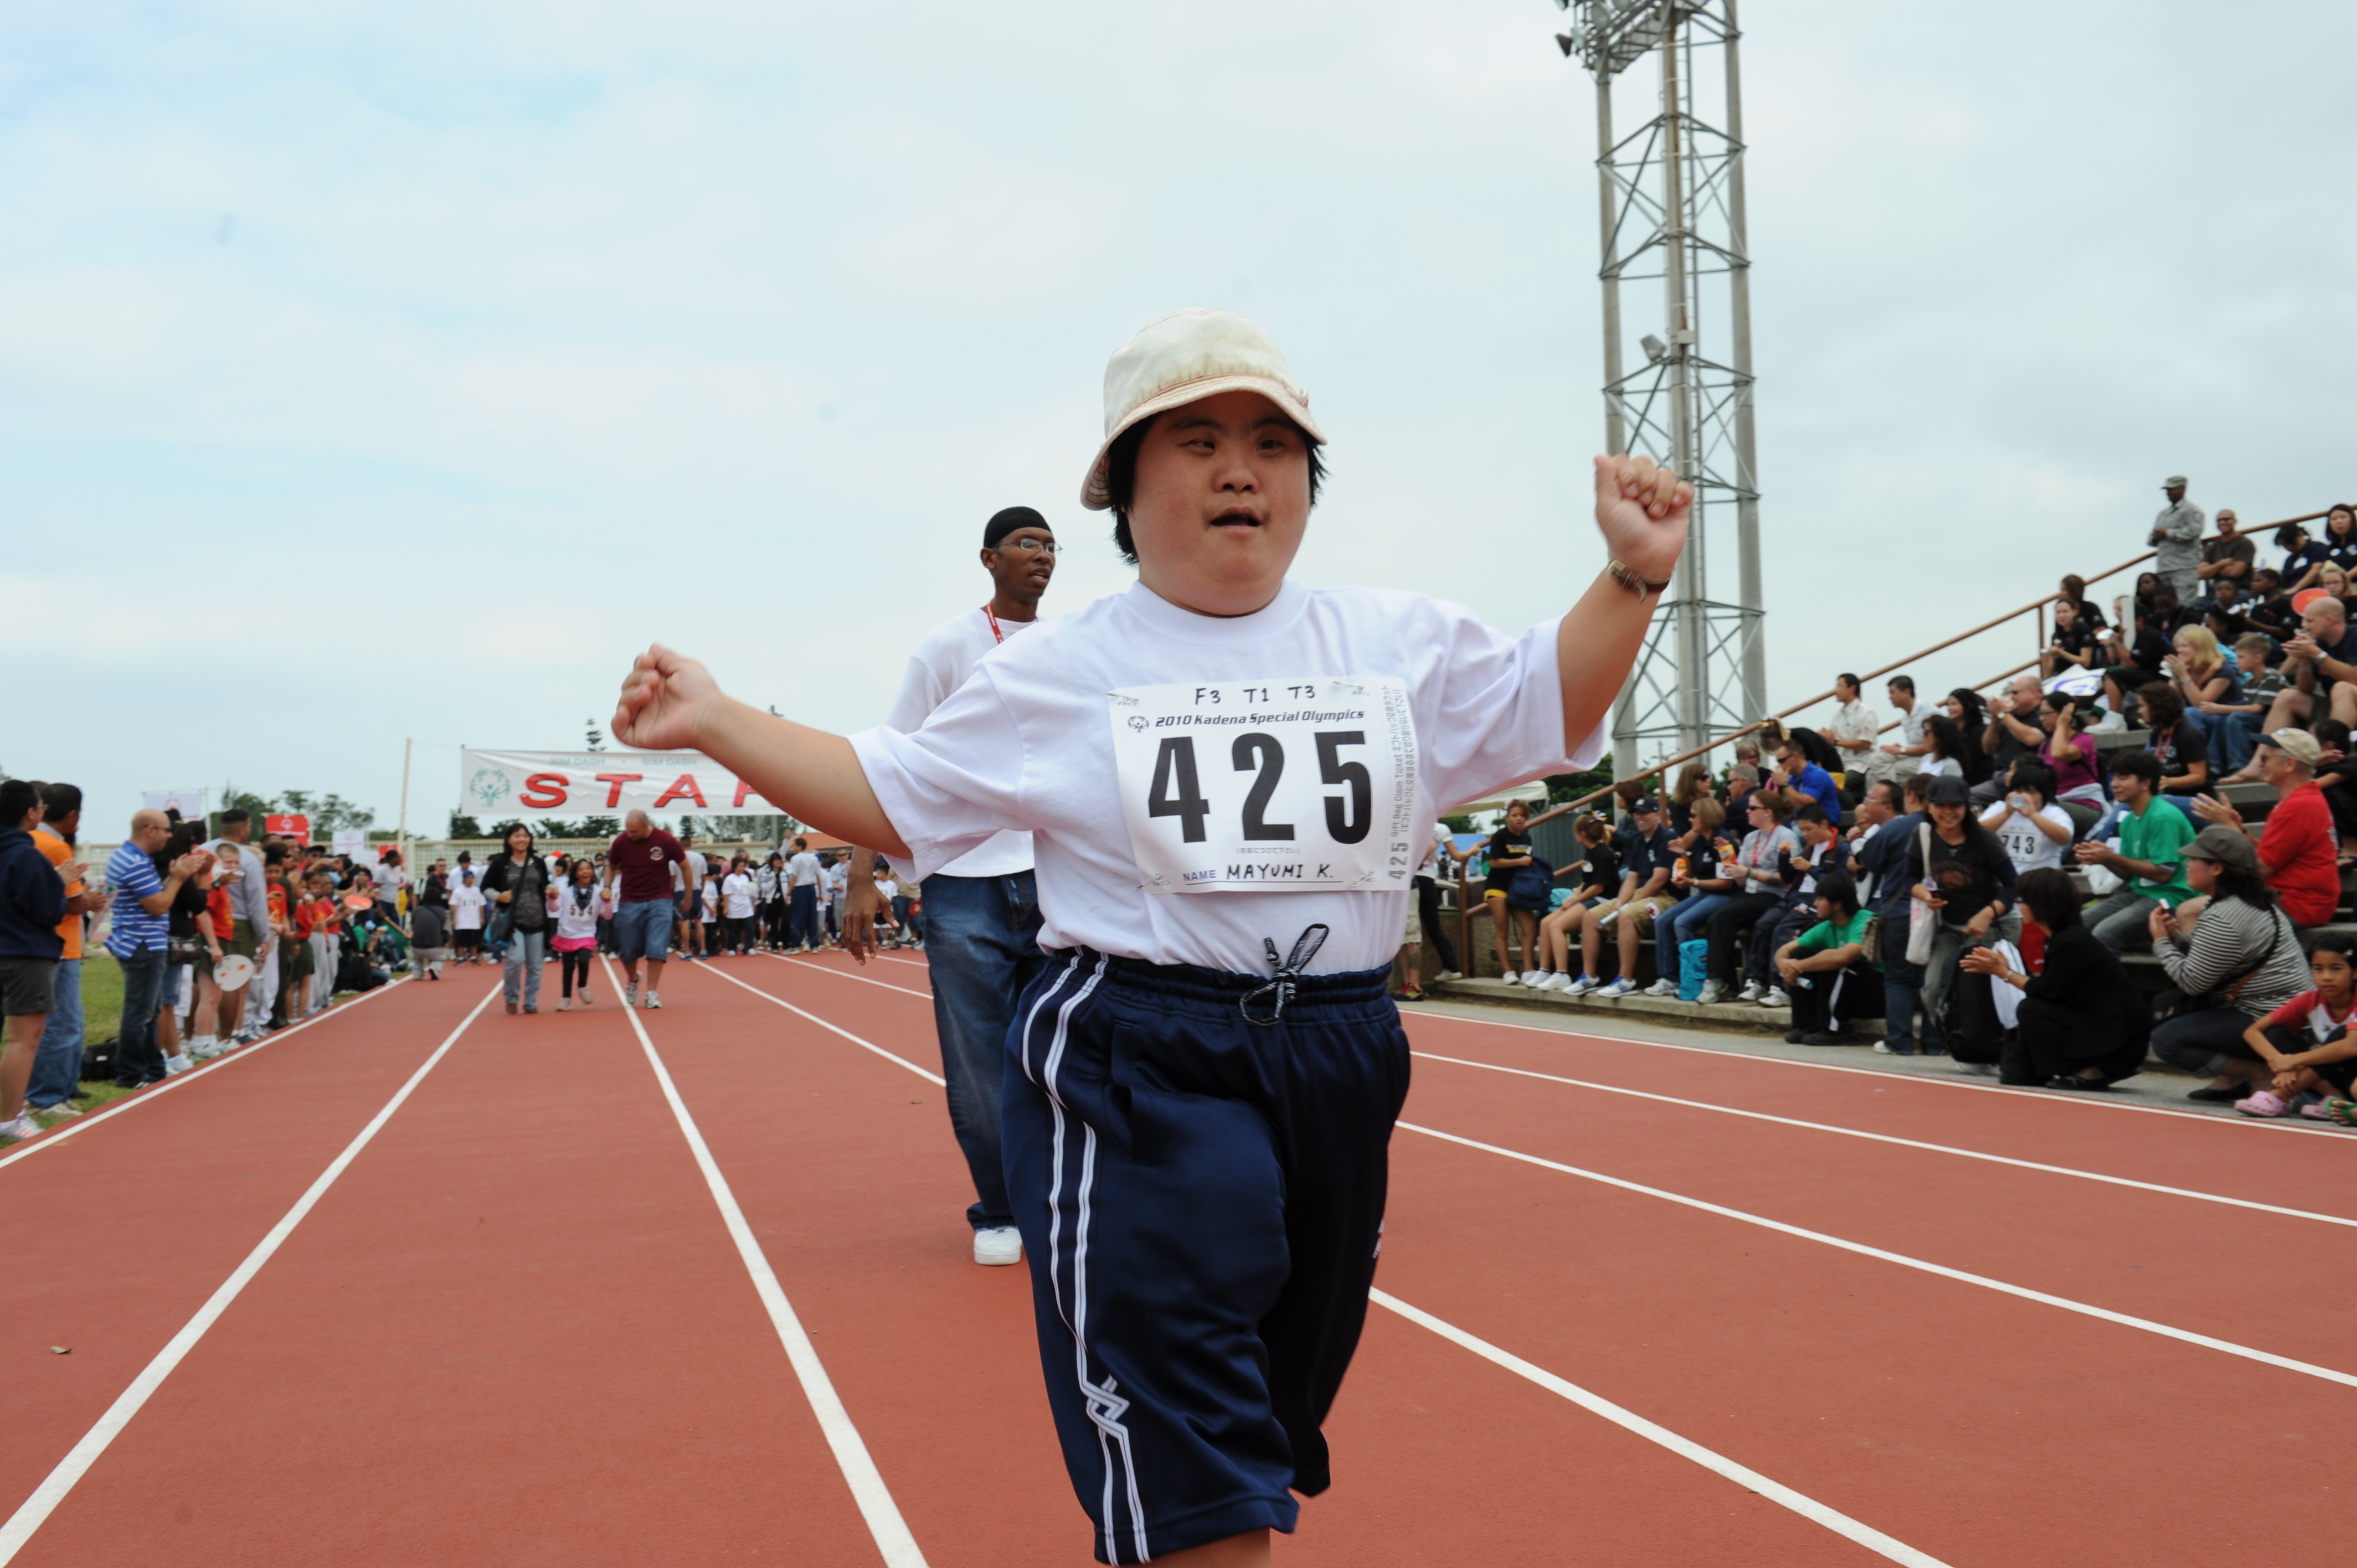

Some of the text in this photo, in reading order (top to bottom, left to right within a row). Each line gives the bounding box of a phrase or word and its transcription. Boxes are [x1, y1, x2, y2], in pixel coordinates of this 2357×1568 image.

[1194, 685, 1315, 705] F3 T1 T3
[1155, 709, 1365, 727] 2010 Kadena Special Olympics
[574, 757, 605, 766] DASH
[666, 758, 696, 766] DASH
[1393, 754, 1404, 778] Ticket
[1148, 730, 1371, 845] 425
[1394, 781, 1404, 802] Claim
[1392, 803, 1403, 819] Bag
[1390, 822, 1400, 837] Gift
[1388, 842, 1409, 880] 425
[1182, 869, 1217, 881] NAME
[1226, 863, 1334, 880] MAYUMI K.
